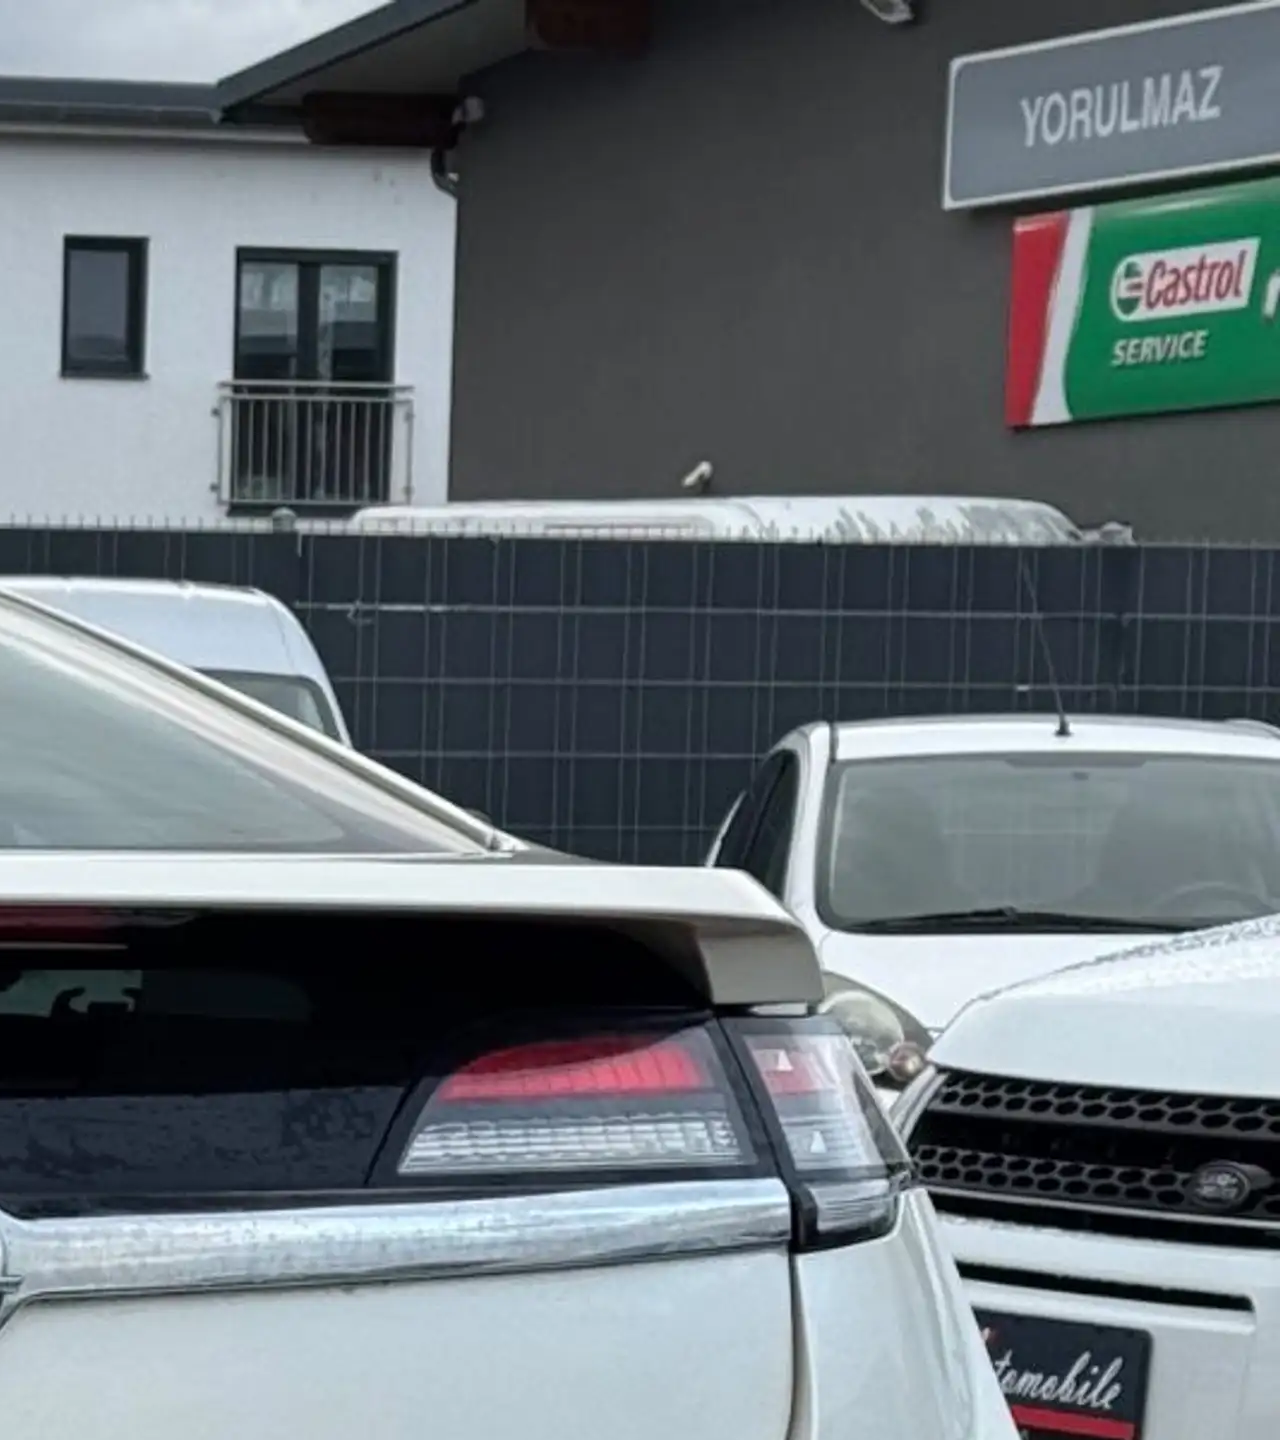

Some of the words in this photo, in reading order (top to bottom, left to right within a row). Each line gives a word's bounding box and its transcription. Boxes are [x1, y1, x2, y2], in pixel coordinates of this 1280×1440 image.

[1020, 65, 1223, 147] YORULMAZ
[1145, 250, 1247, 310] Castrol
[1111, 330, 1208, 366] SERVICE
[993, 1350, 1124, 1410] tomobile
